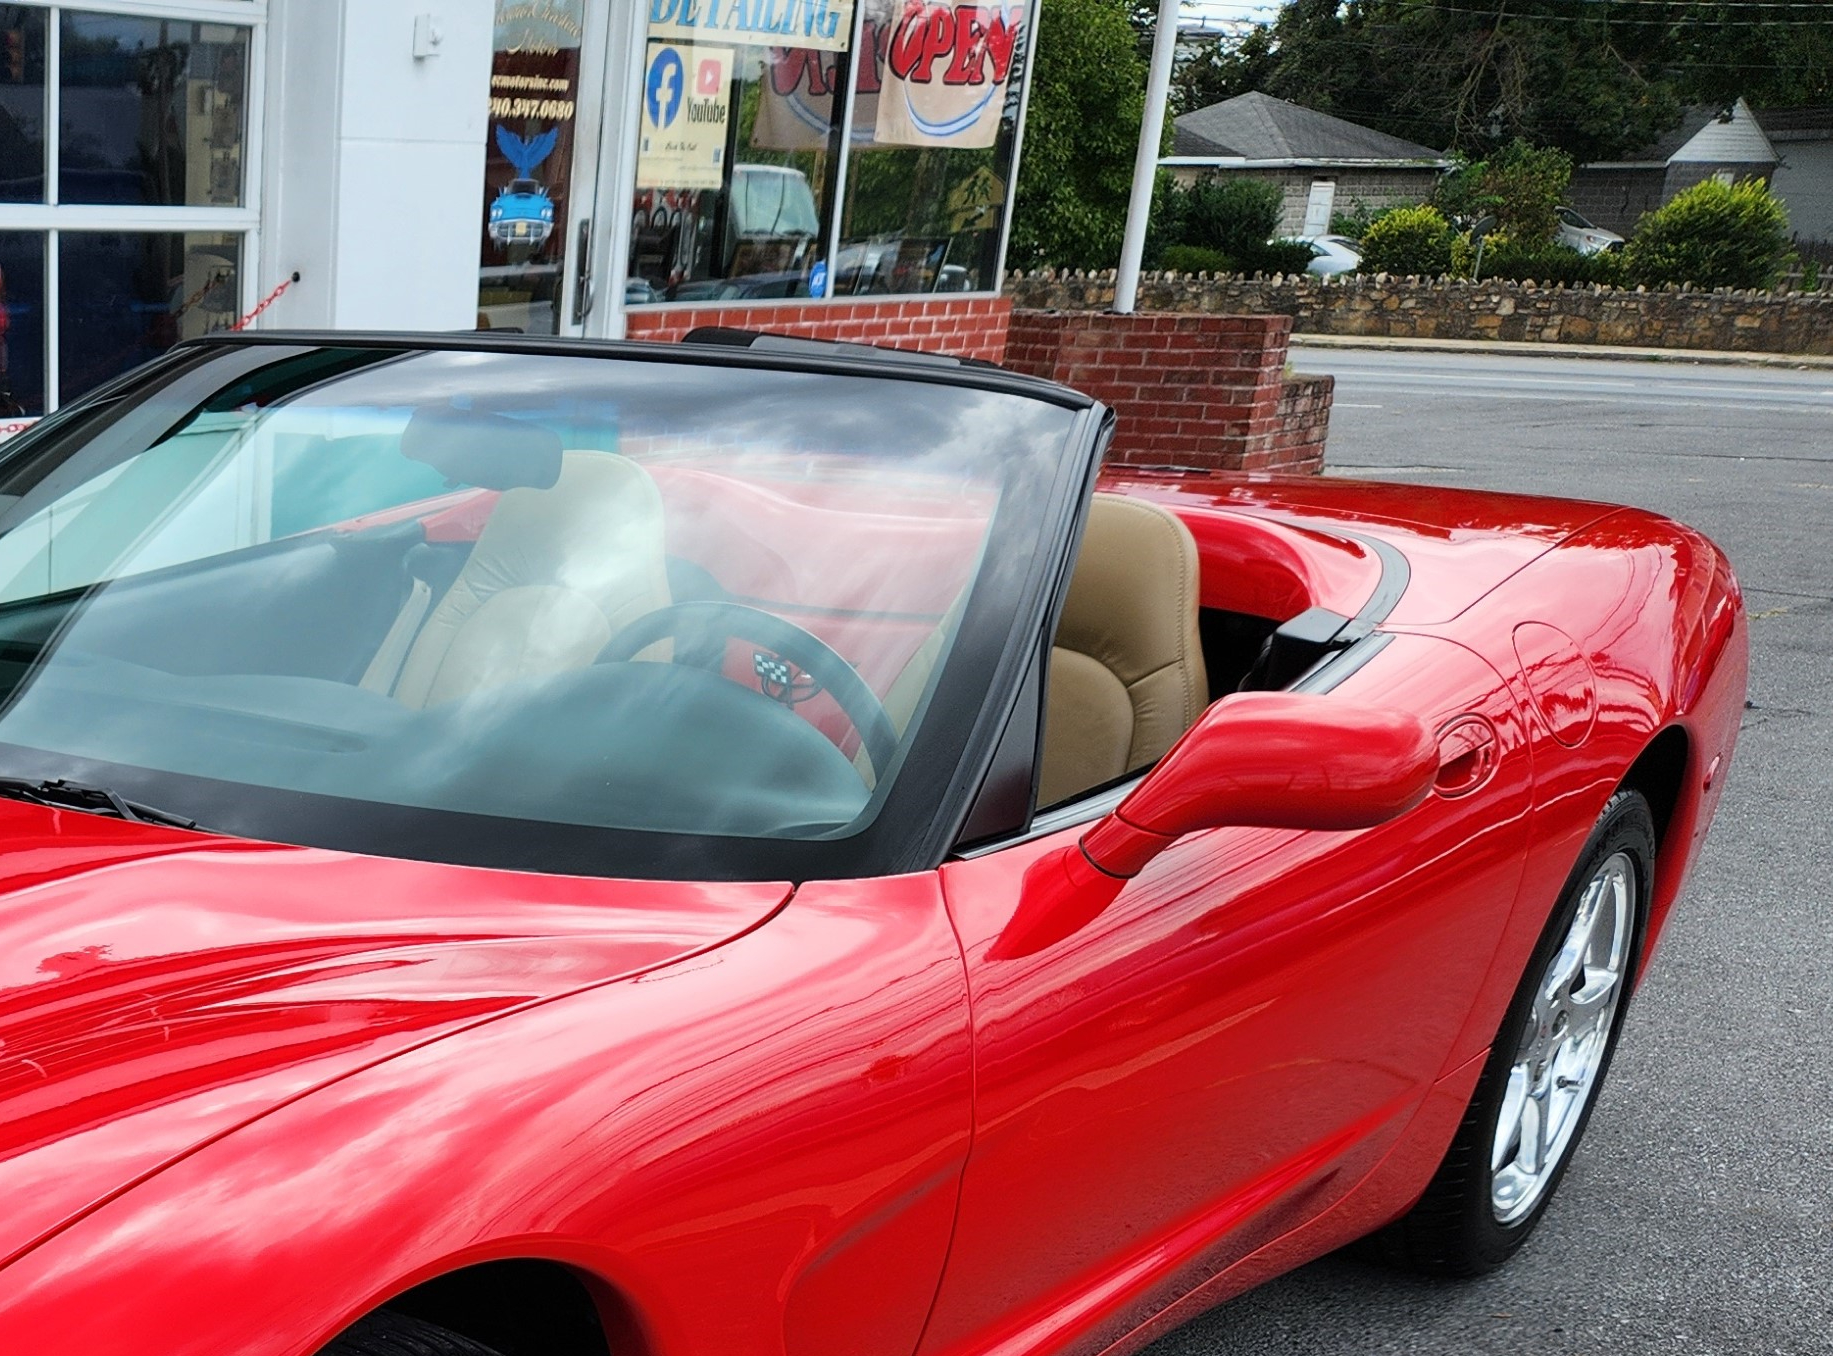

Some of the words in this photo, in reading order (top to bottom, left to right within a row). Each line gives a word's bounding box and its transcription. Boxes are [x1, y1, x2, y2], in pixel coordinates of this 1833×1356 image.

[650, 0, 840, 39] DETAILING
[888, 2, 1023, 85] OPEN
[686, 97, 725, 124] YouTube
